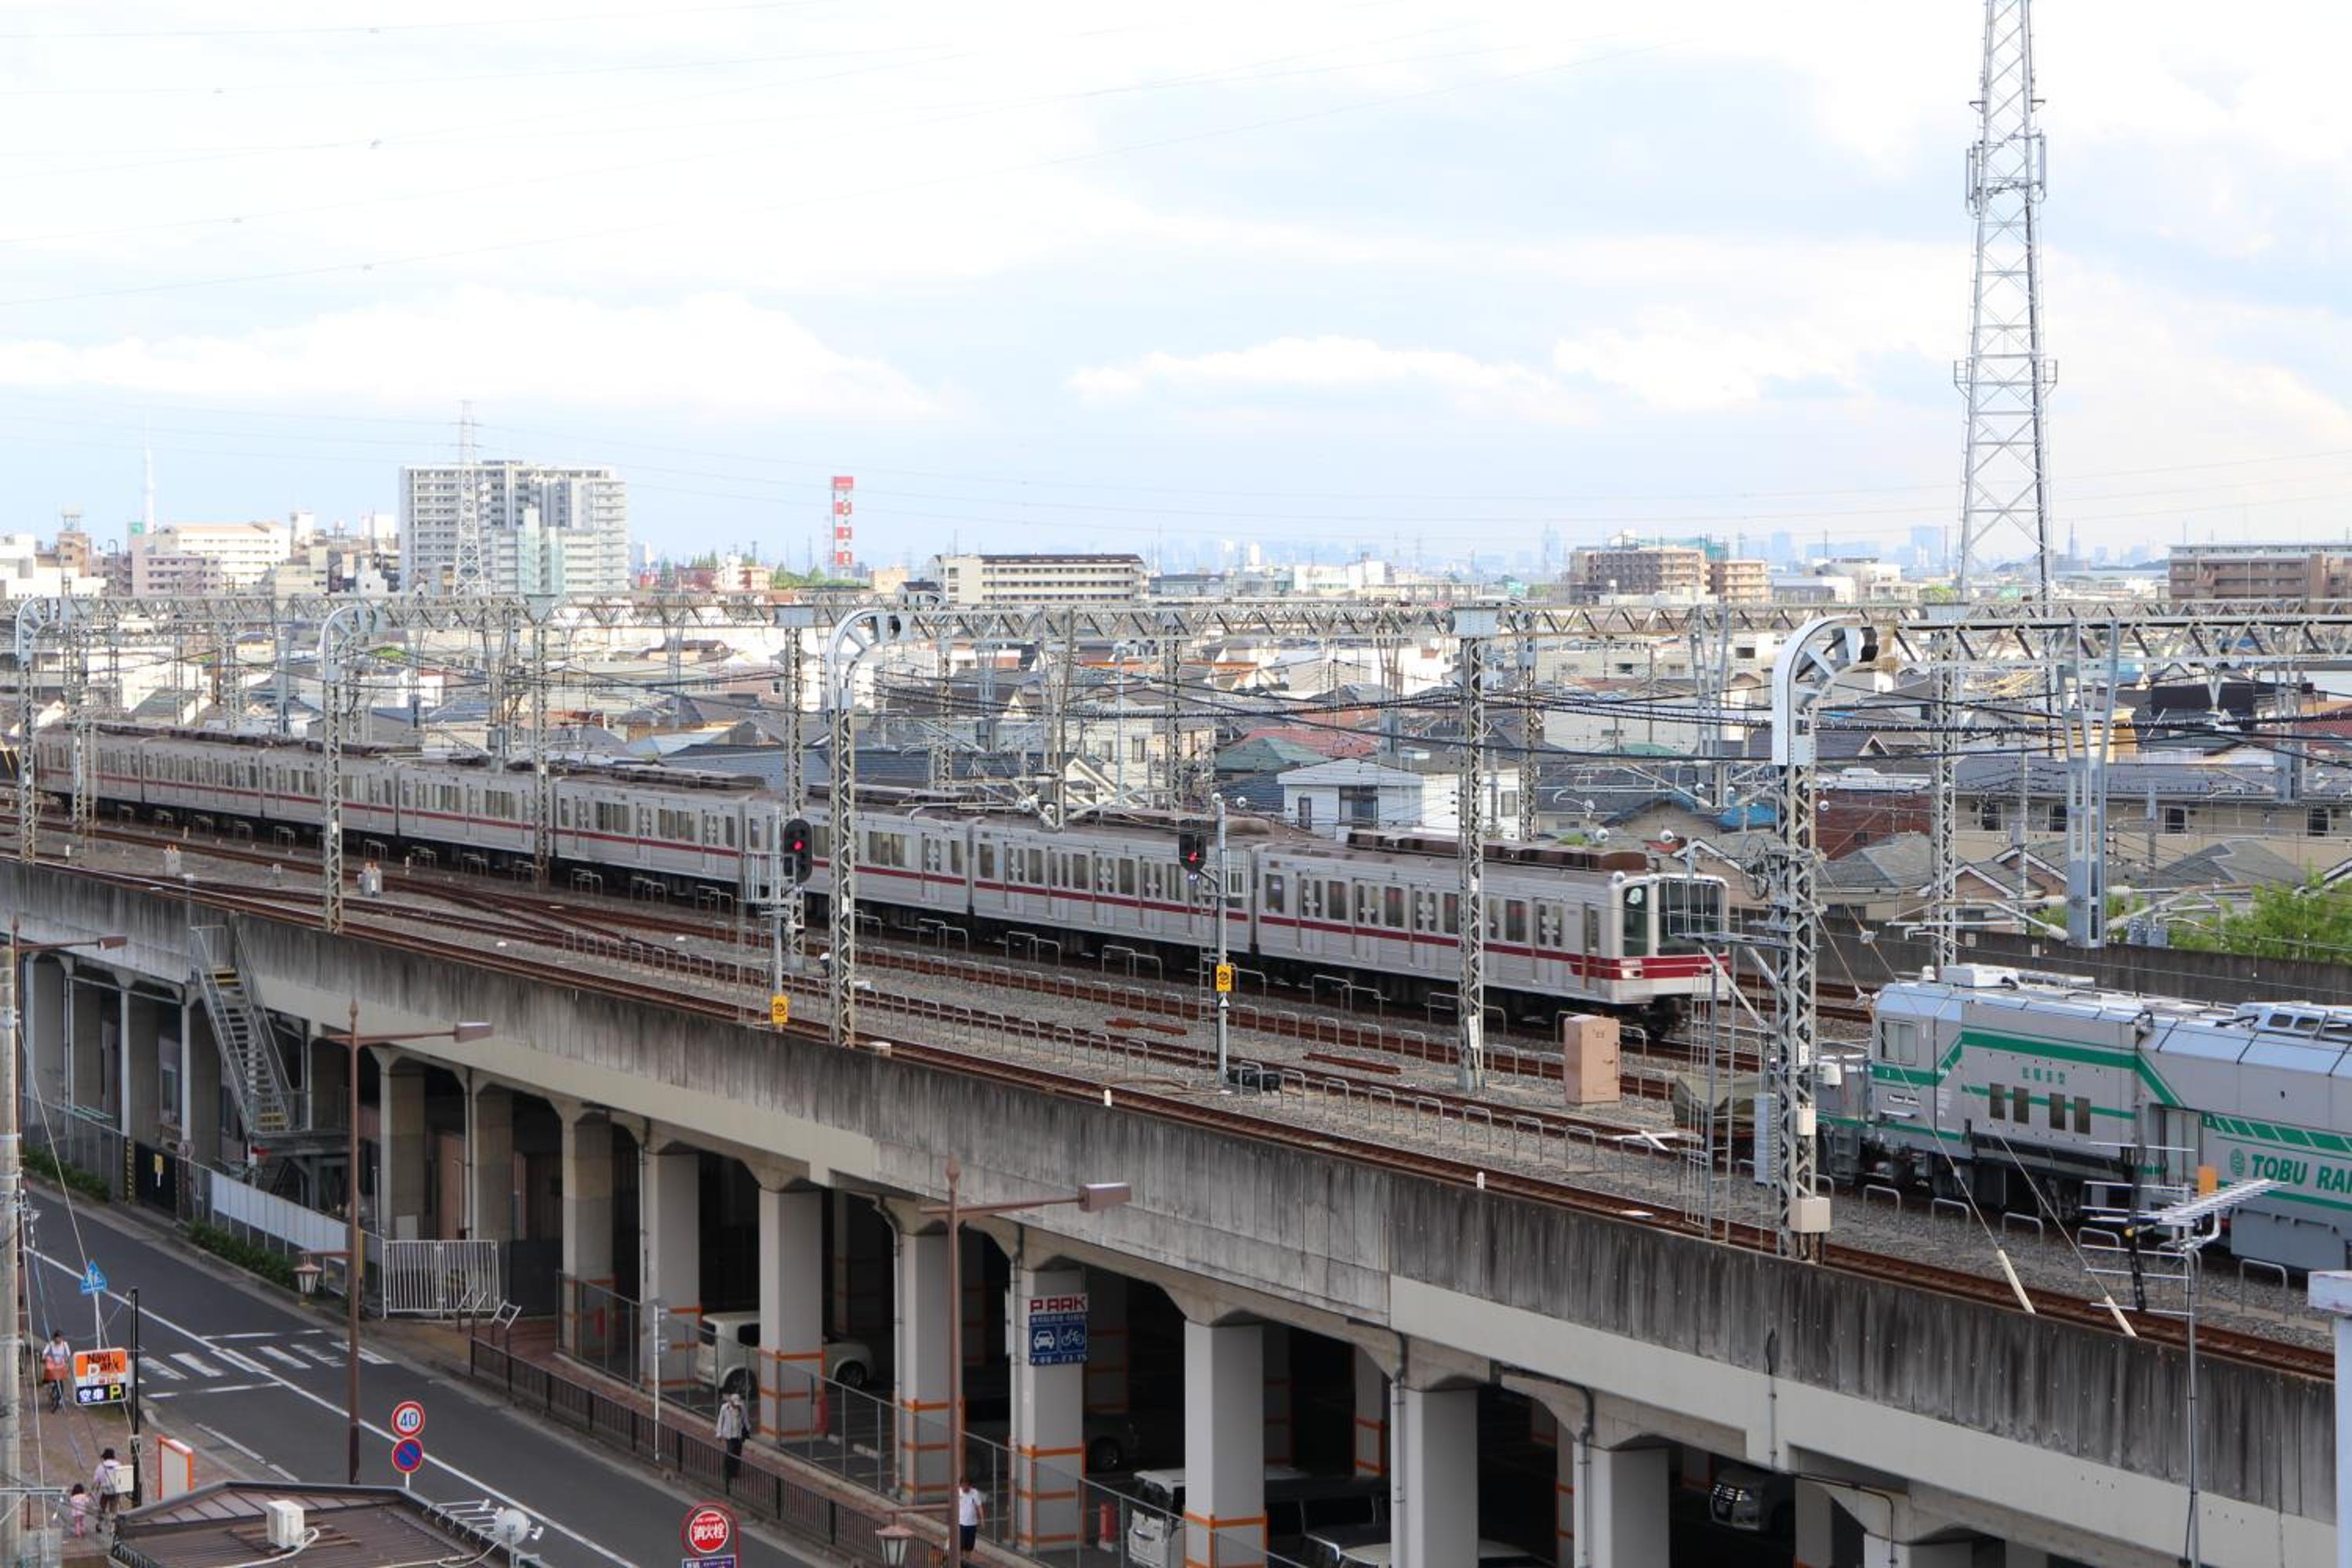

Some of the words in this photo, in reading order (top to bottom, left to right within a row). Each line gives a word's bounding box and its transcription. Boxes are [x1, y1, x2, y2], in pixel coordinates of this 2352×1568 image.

[2252, 1153, 2308, 1185] TOBU
[1030, 1297, 1086, 1312] PARK
[110, 1384, 122, 1399] P
[401, 1412, 418, 1427] 40
[693, 1523, 726, 1541] 消火栓
